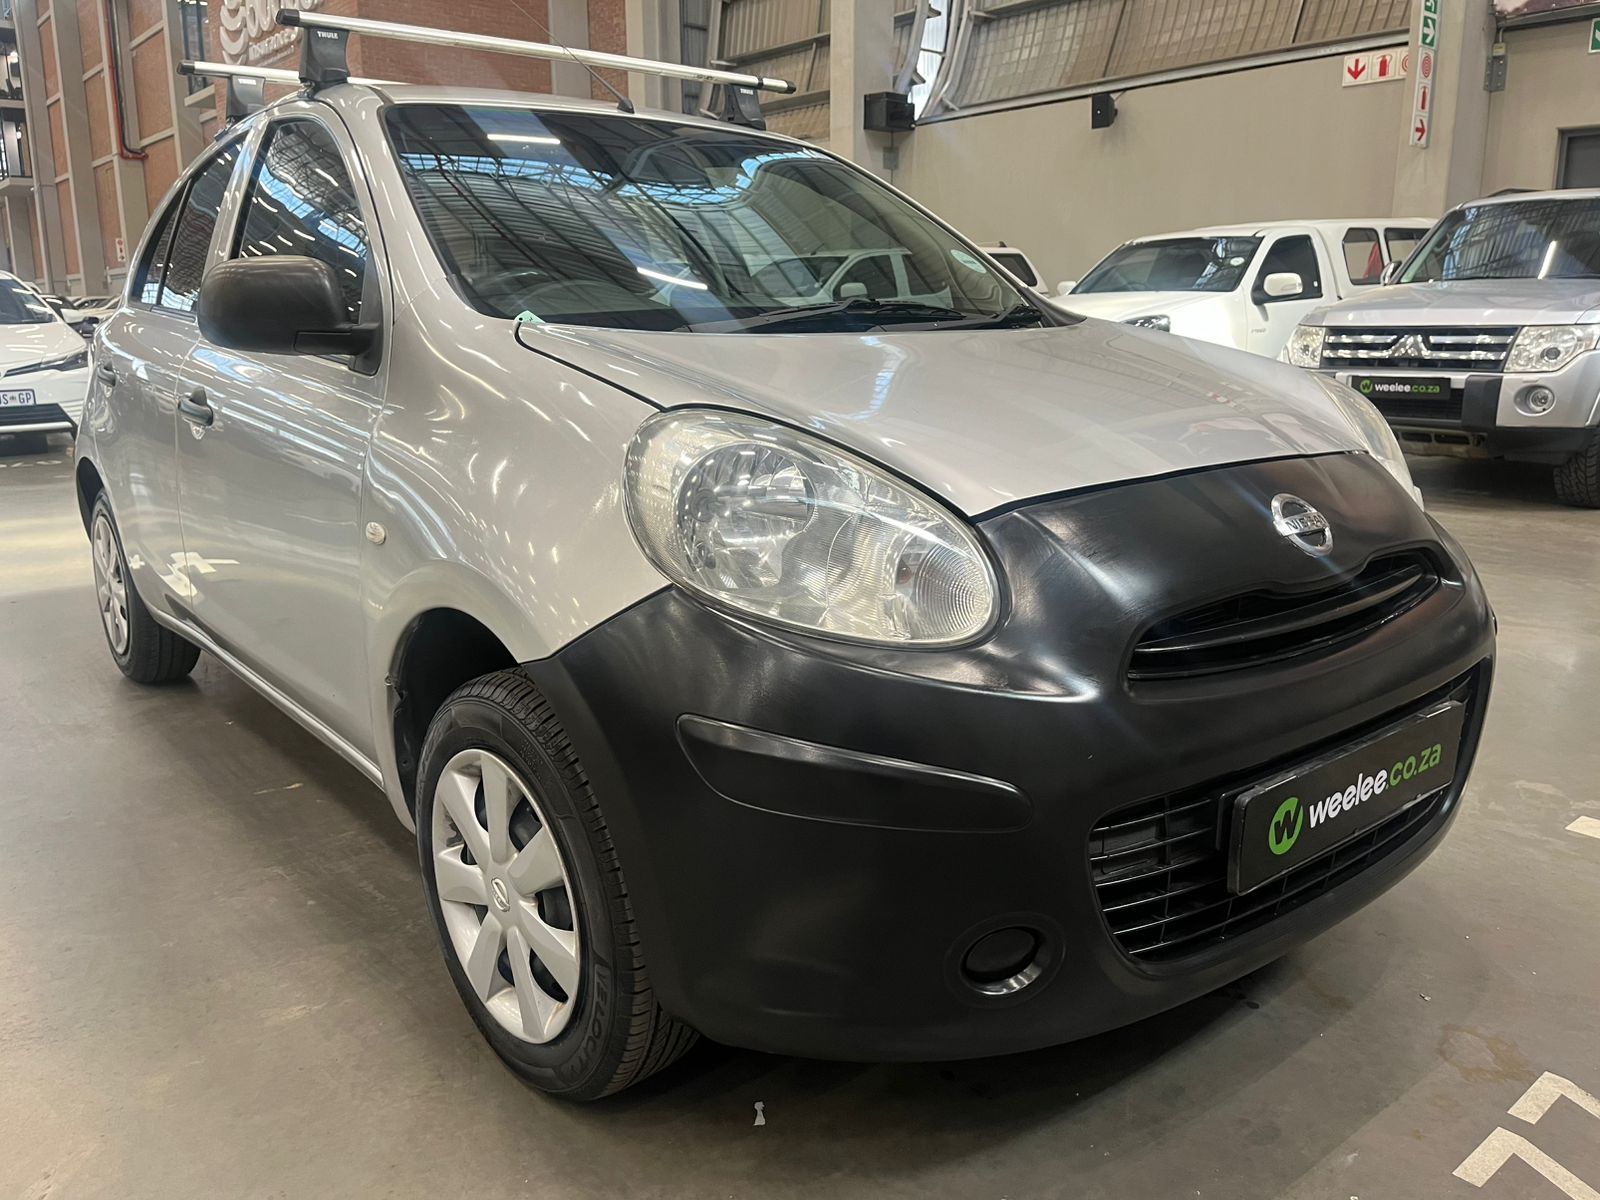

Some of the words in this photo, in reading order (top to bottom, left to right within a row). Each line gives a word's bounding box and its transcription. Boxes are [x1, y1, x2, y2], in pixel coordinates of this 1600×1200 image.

[317, 30, 339, 39] THULE
[1374, 382, 1440, 393] weelee.co.za
[18, 392, 32, 404] GP
[1309, 743, 1442, 829] weelee.co.za
